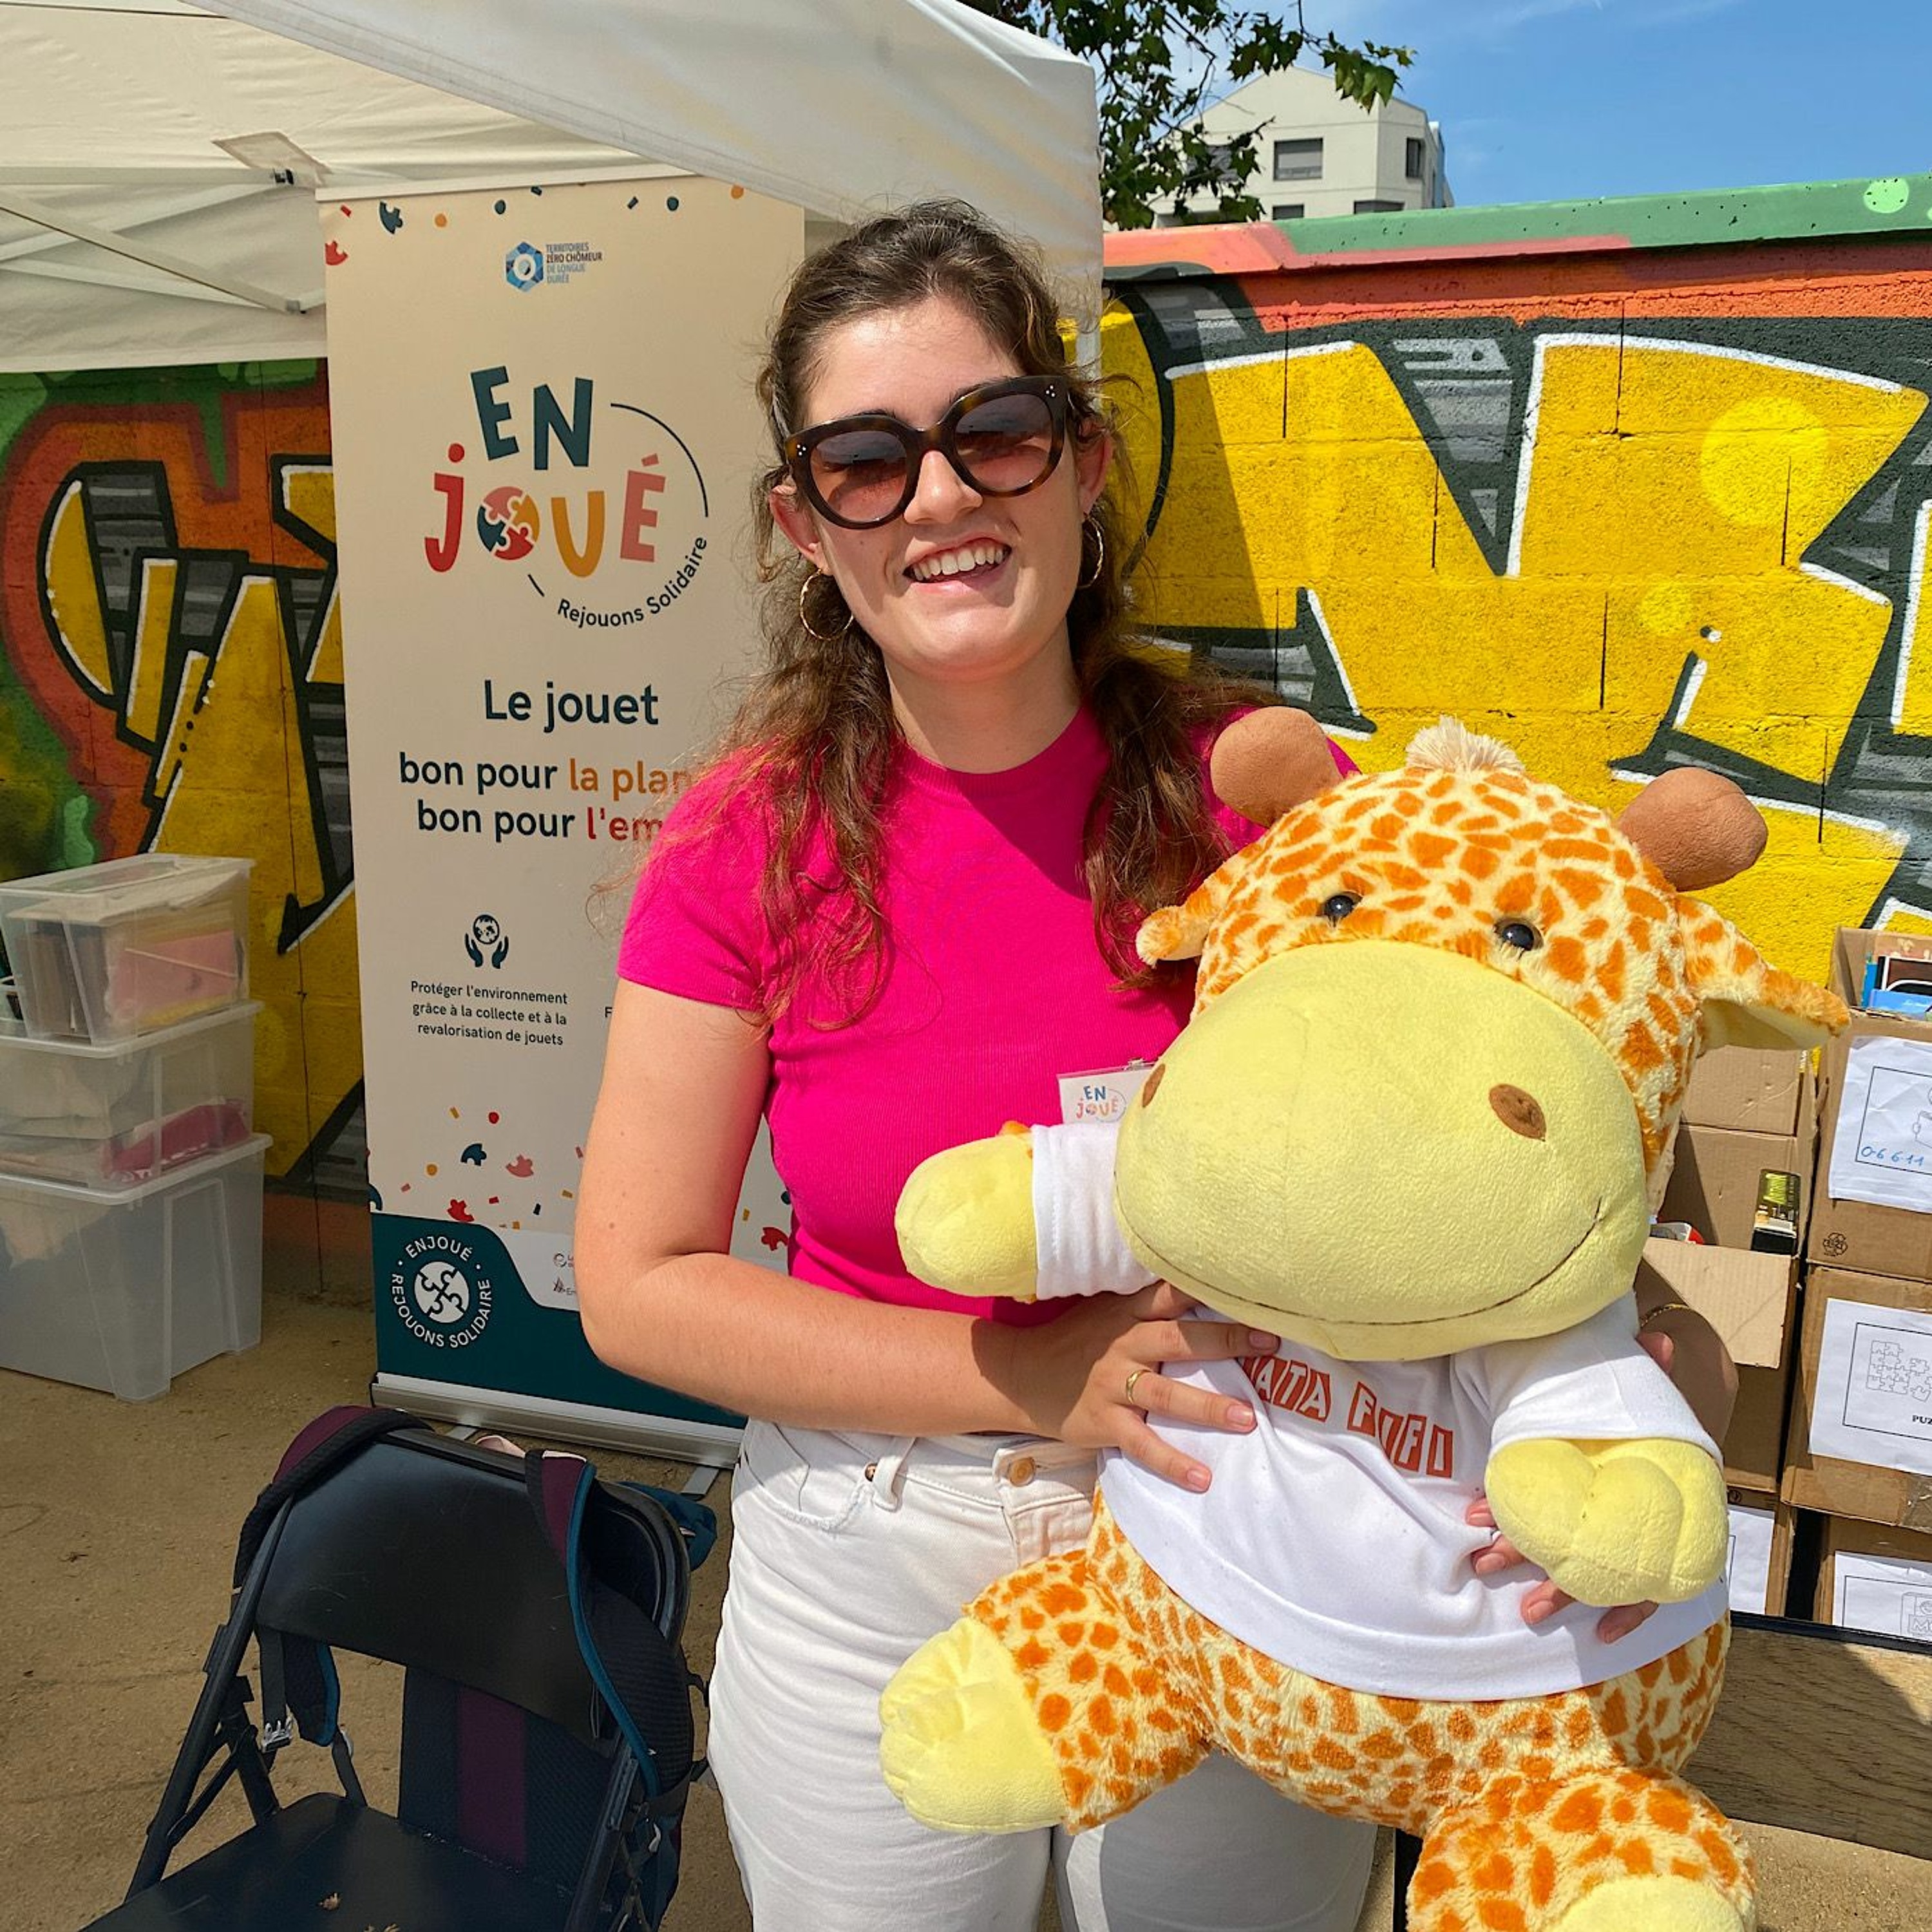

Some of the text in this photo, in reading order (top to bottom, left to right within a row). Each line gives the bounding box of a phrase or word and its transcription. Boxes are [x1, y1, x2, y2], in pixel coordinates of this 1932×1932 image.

[546, 251, 602, 263] ZÉRO CHÔMEUR
[471, 366, 593, 470] EN
[558, 536, 707, 628] Rejouons Solidaire
[484, 680, 658, 733] Le jouet
[399, 752, 464, 786] bon
[477, 763, 558, 795] pour
[570, 759, 598, 791] la
[417, 799, 481, 833] bon
[495, 810, 575, 843] pour
[411, 981, 567, 1004] Protéger l'environnement
[413, 1003, 567, 1025] grâce à la collecte et à la
[418, 1023, 564, 1045] revalorisation de jouets
[1083, 1086, 1106, 1101] EN
[406, 1236, 473, 1261] ENJOUÉ
[392, 1274, 492, 1348] REJOUONS SOLIDAIRE
[1348, 1381, 1454, 1479] FIFI
